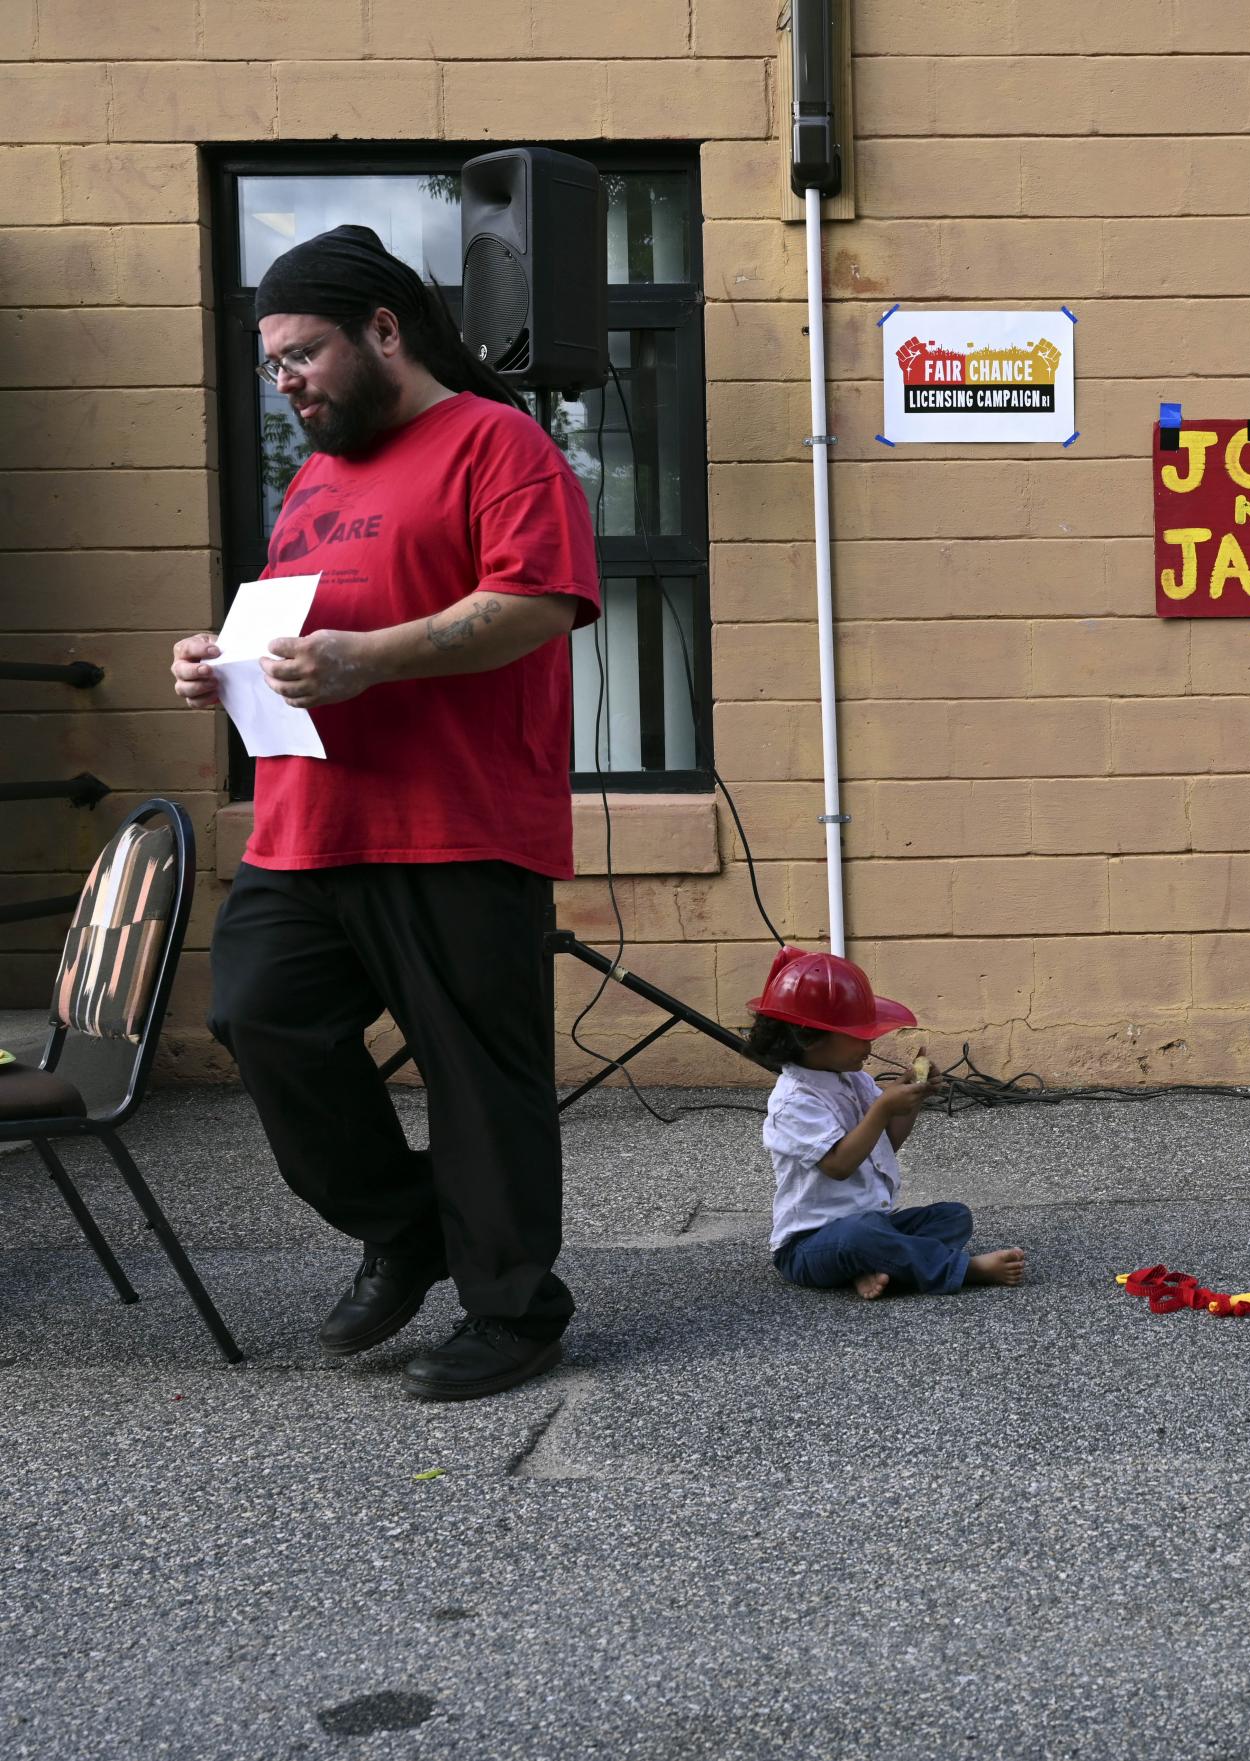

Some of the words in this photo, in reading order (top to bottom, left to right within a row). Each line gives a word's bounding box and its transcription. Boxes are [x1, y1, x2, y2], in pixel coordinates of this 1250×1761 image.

[924, 360, 962, 382] FAIR
[969, 360, 1033, 382] CHANCE
[909, 390, 974, 408] LICENSING
[977, 390, 1041, 408] CAMPAIGN
